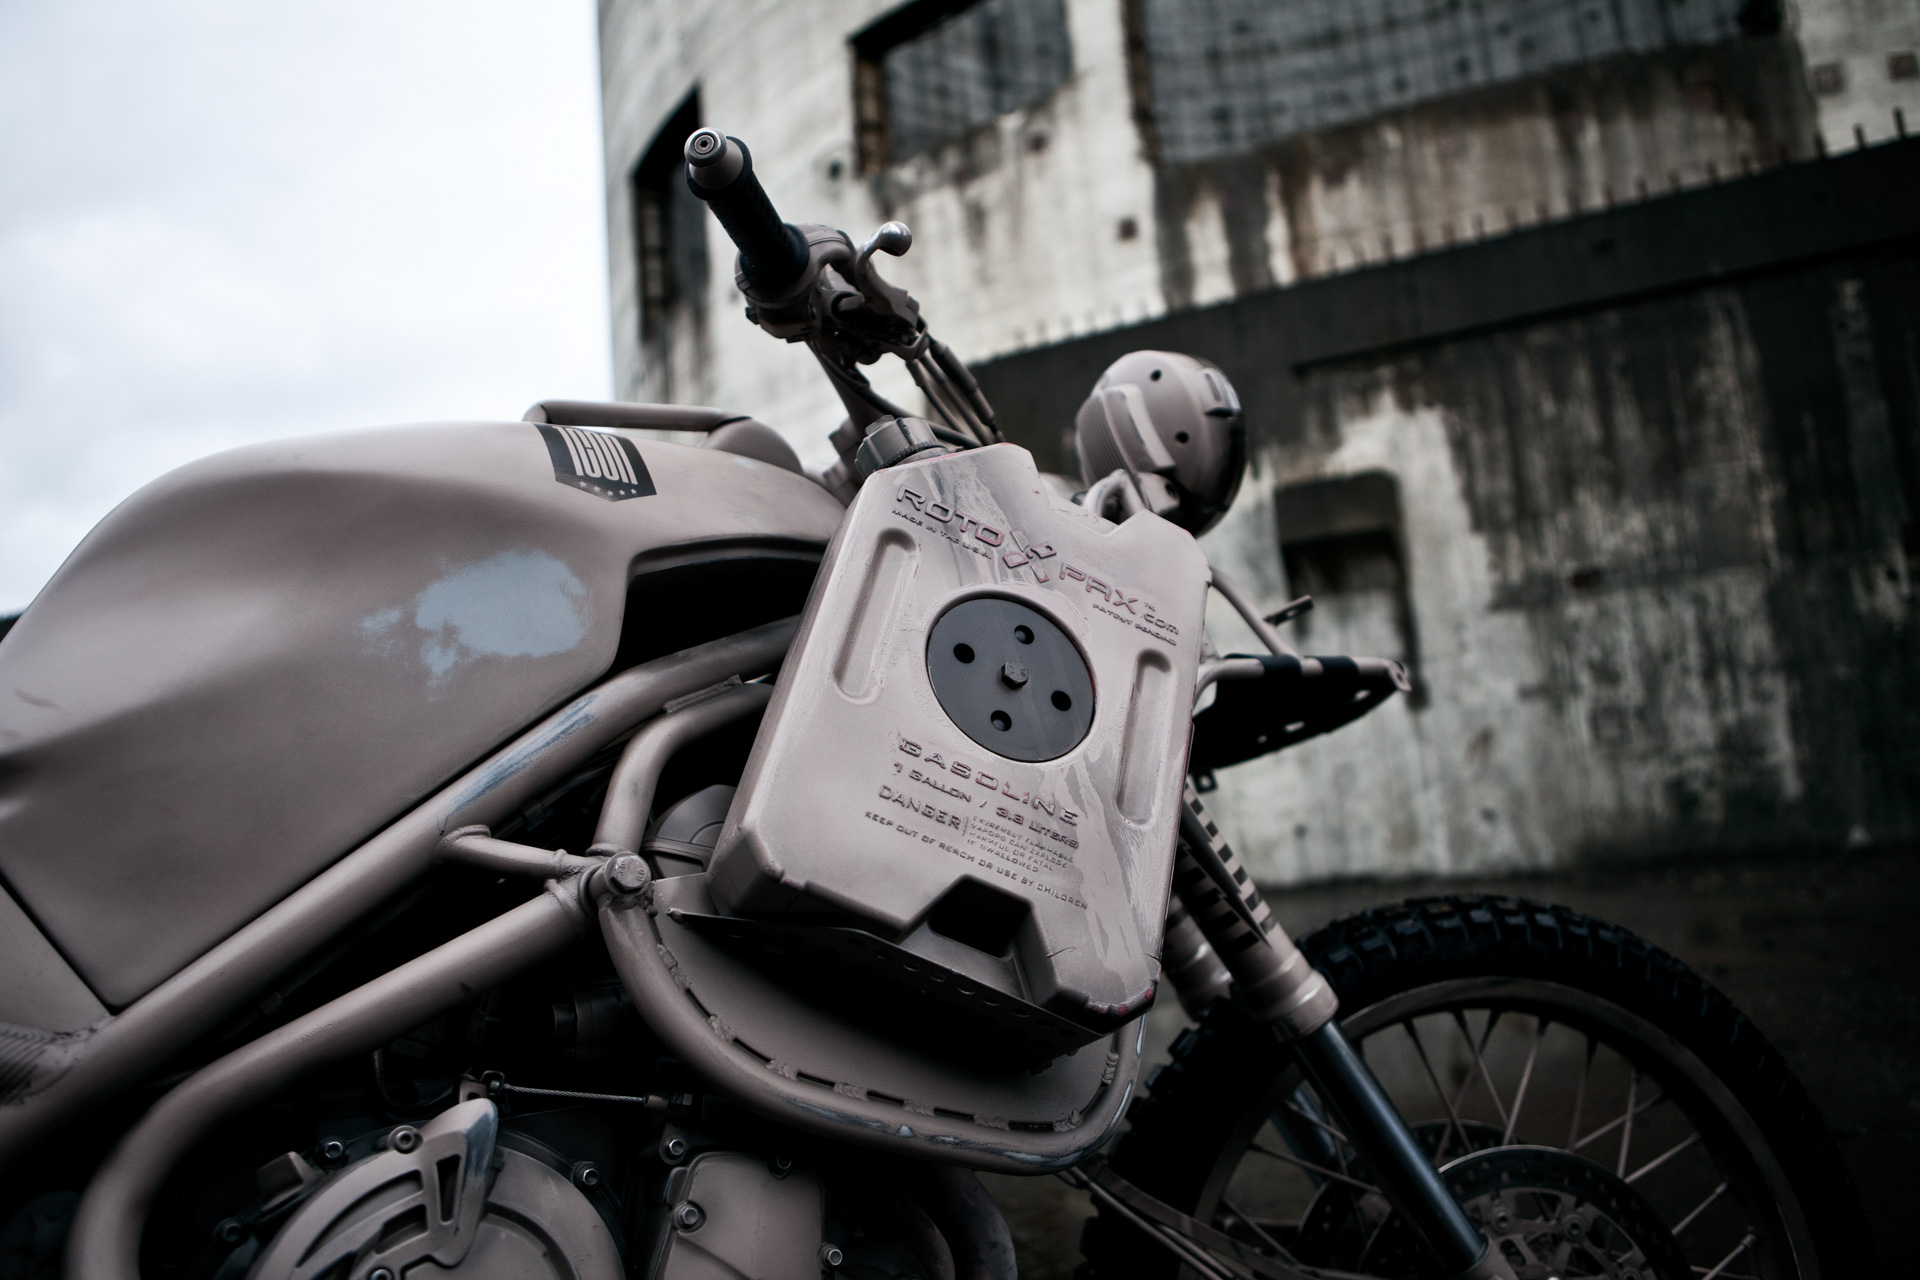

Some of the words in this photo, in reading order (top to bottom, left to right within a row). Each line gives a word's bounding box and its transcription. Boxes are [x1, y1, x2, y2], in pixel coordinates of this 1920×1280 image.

[892, 509, 923, 527] MADE
[896, 485, 1005, 548] ROTO
[1058, 562, 1138, 615] PAX
[1134, 623, 1177, 647] PENDING
[879, 785, 961, 831] DANGER
[899, 738, 1079, 827] GASOLINE
[909, 769, 972, 803] GALLON
[1028, 818, 1080, 850] LITERS
[864, 810, 894, 827] KEEP
[896, 824, 919, 838] OUT
[921, 834, 936, 845] OF
[938, 842, 975, 862] REACH
[978, 858, 993, 870] OR
[996, 867, 1018, 881] USE
[1020, 876, 1034, 887] BY
[1036, 883, 1088, 910] CHILDREN
